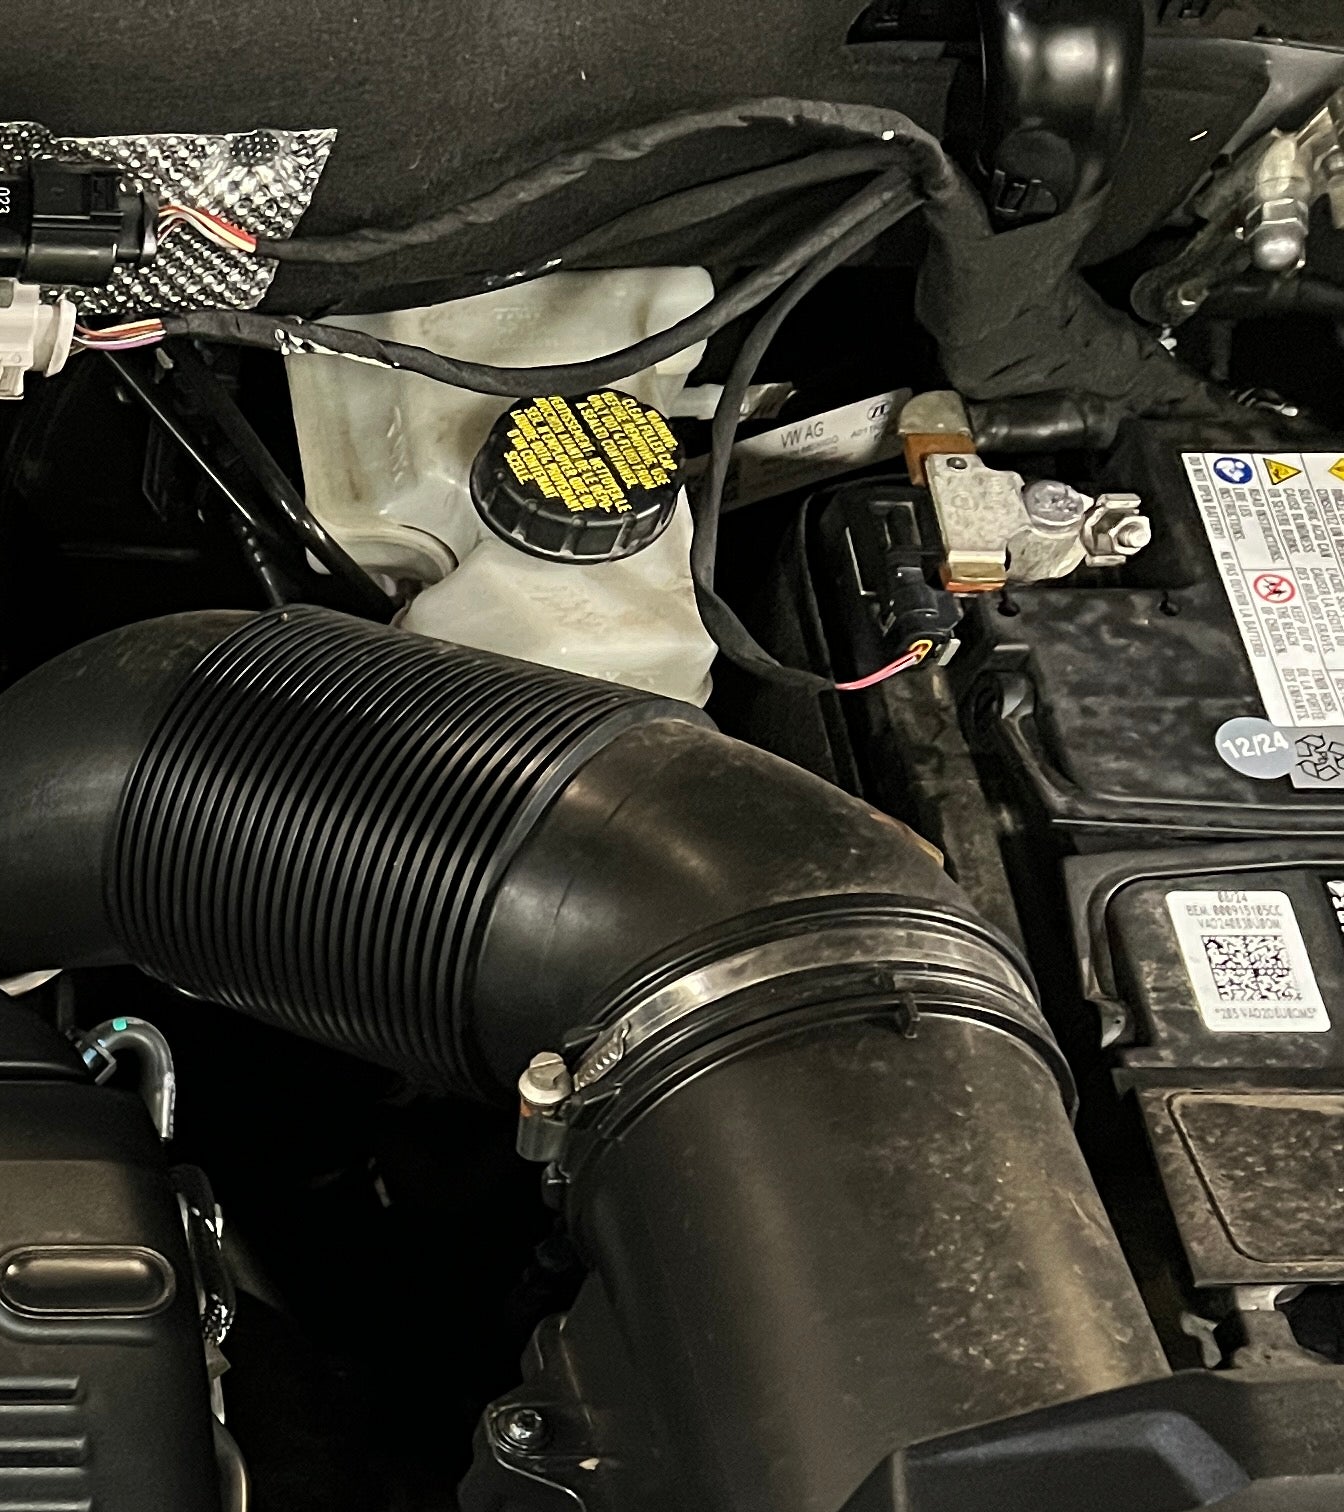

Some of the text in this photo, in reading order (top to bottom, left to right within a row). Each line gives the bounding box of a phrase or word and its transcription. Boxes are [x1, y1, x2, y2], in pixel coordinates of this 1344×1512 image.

[576, 402, 589, 410] A
[581, 409, 609, 439] SEALED
[622, 399, 677, 470] CLEAN FILLER CAP
[780, 421, 825, 449] VW AG
[650, 467, 670, 485] USE
[1221, 731, 1289, 759] 12/24
